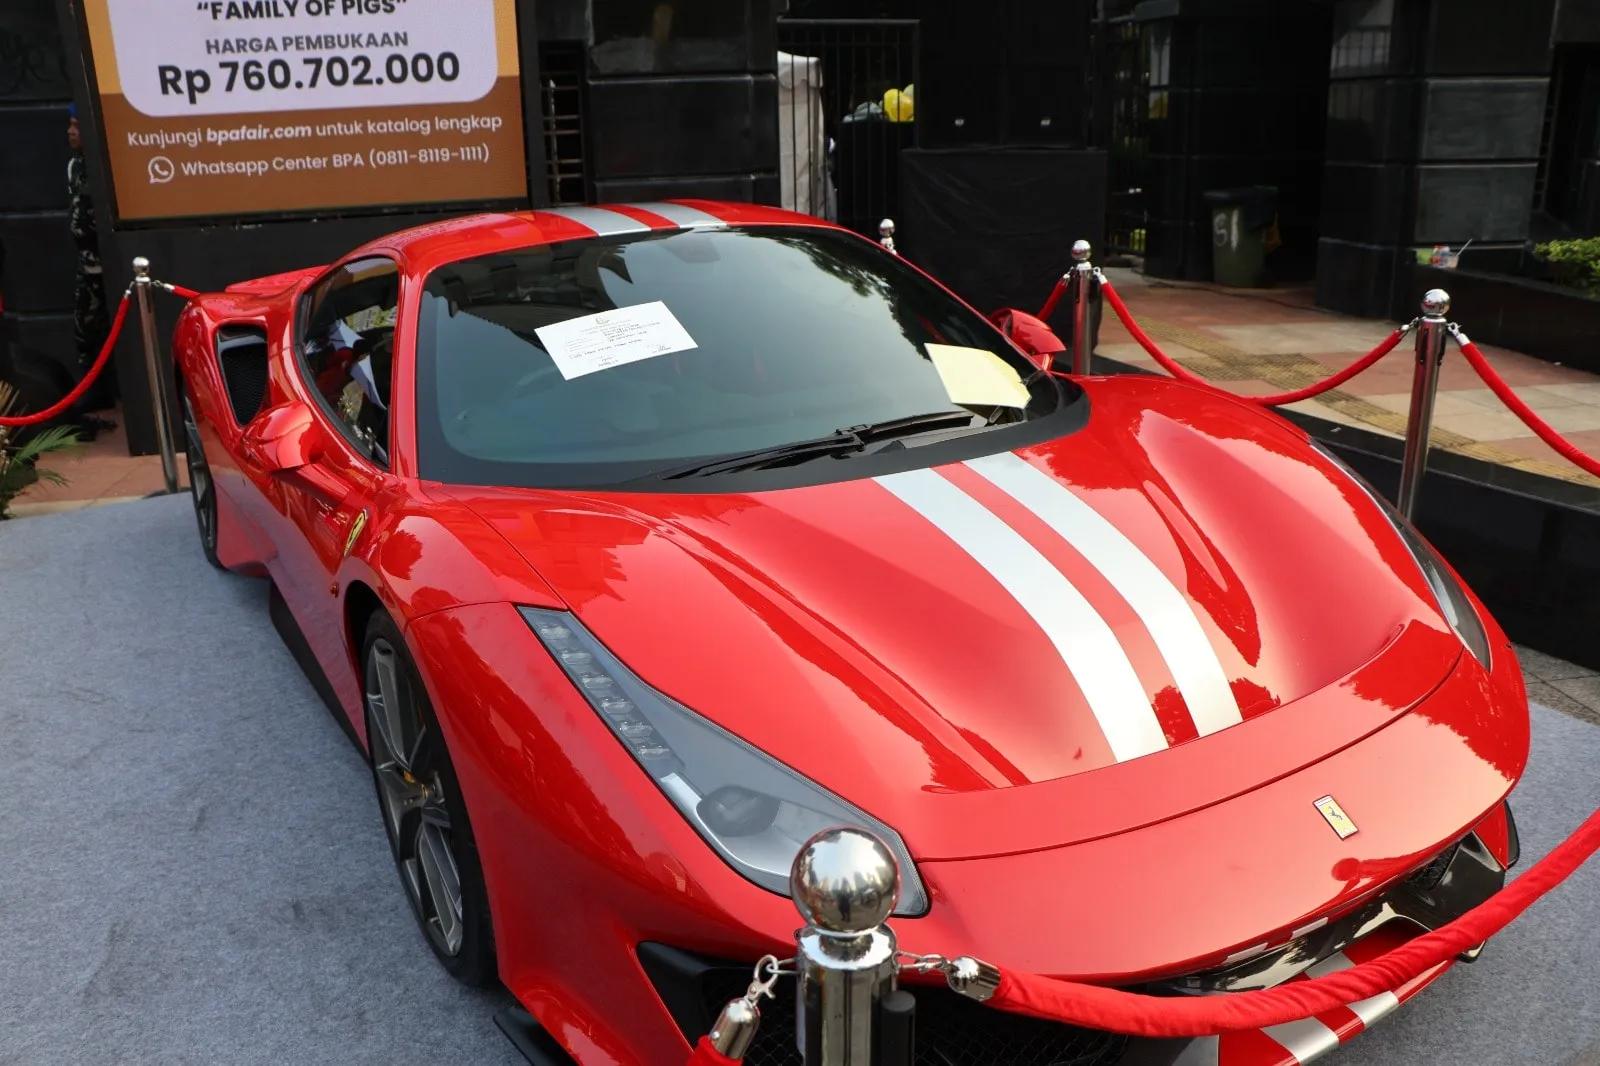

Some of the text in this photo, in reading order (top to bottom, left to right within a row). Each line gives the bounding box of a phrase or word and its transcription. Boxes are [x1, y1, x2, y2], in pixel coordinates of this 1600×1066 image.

[305, 0, 335, 16] OF
[206, 32, 408, 54] HARGA PEMBUKAAN
[158, 52, 460, 104] Rp 760.702.000
[127, 115, 502, 148] Kunjungi bpafair.com untuk katalog lengkap
[181, 143, 490, 176] Whatsapp Center BPA (0811-8119-1111)
